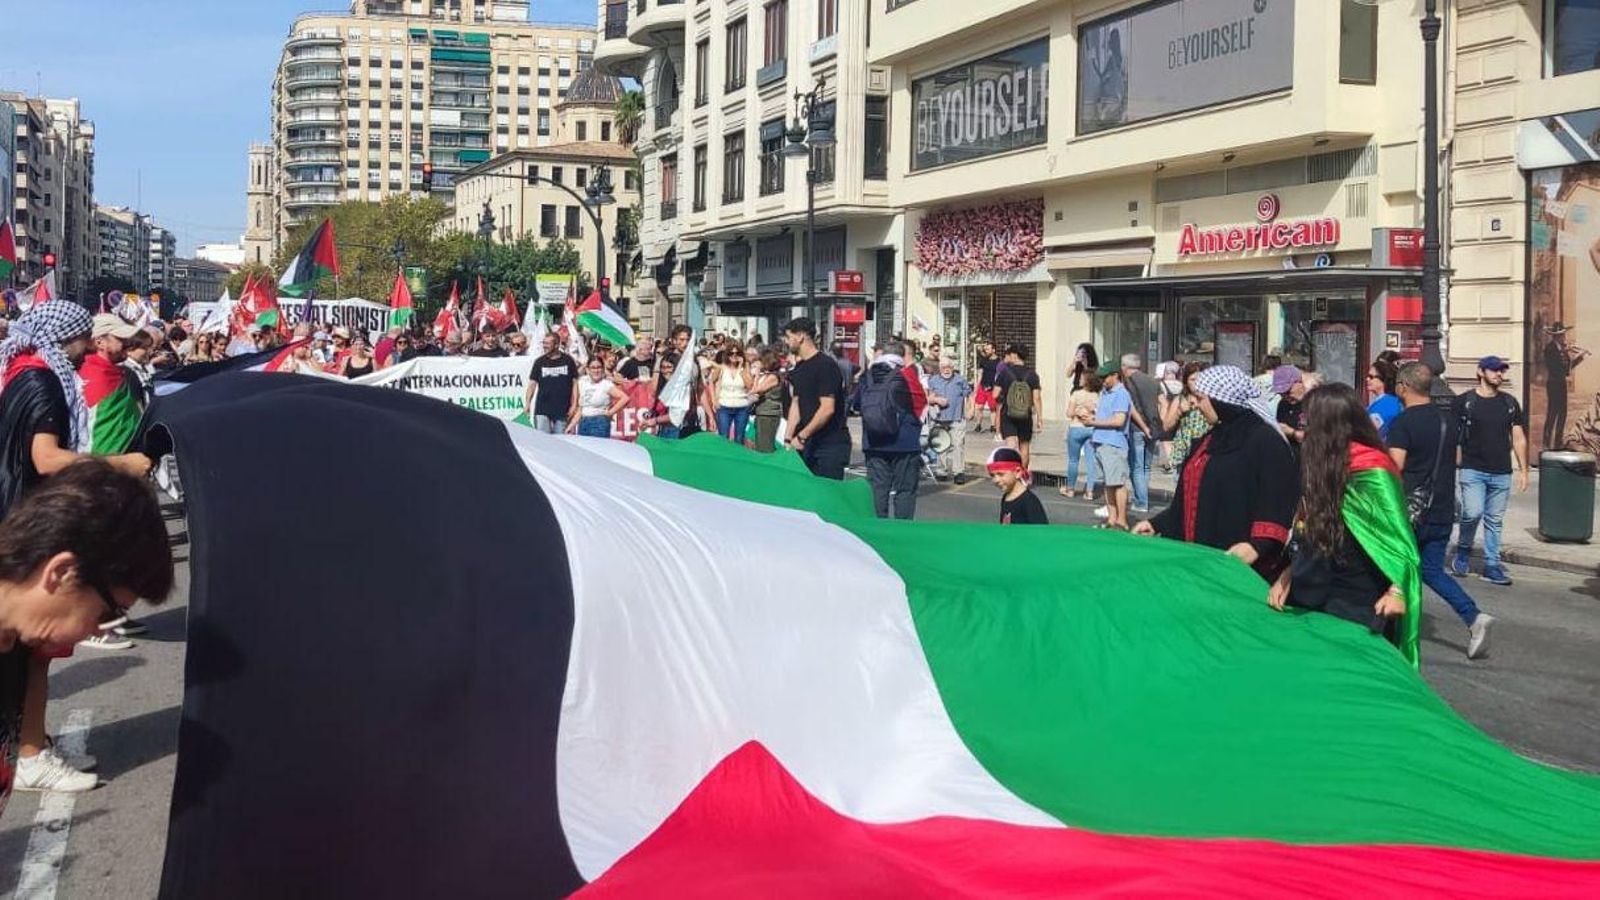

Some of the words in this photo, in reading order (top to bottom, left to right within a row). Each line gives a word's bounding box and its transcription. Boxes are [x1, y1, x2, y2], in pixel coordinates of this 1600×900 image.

[1168, 17, 1255, 70] BEYOURSELF
[917, 63, 1049, 155] BEYOURSELF
[1179, 217, 1341, 257] American
[332, 305, 391, 333] SIONIST
[400, 373, 523, 390] INTERNACIONALISTA
[459, 396, 524, 411] PALESTINA
